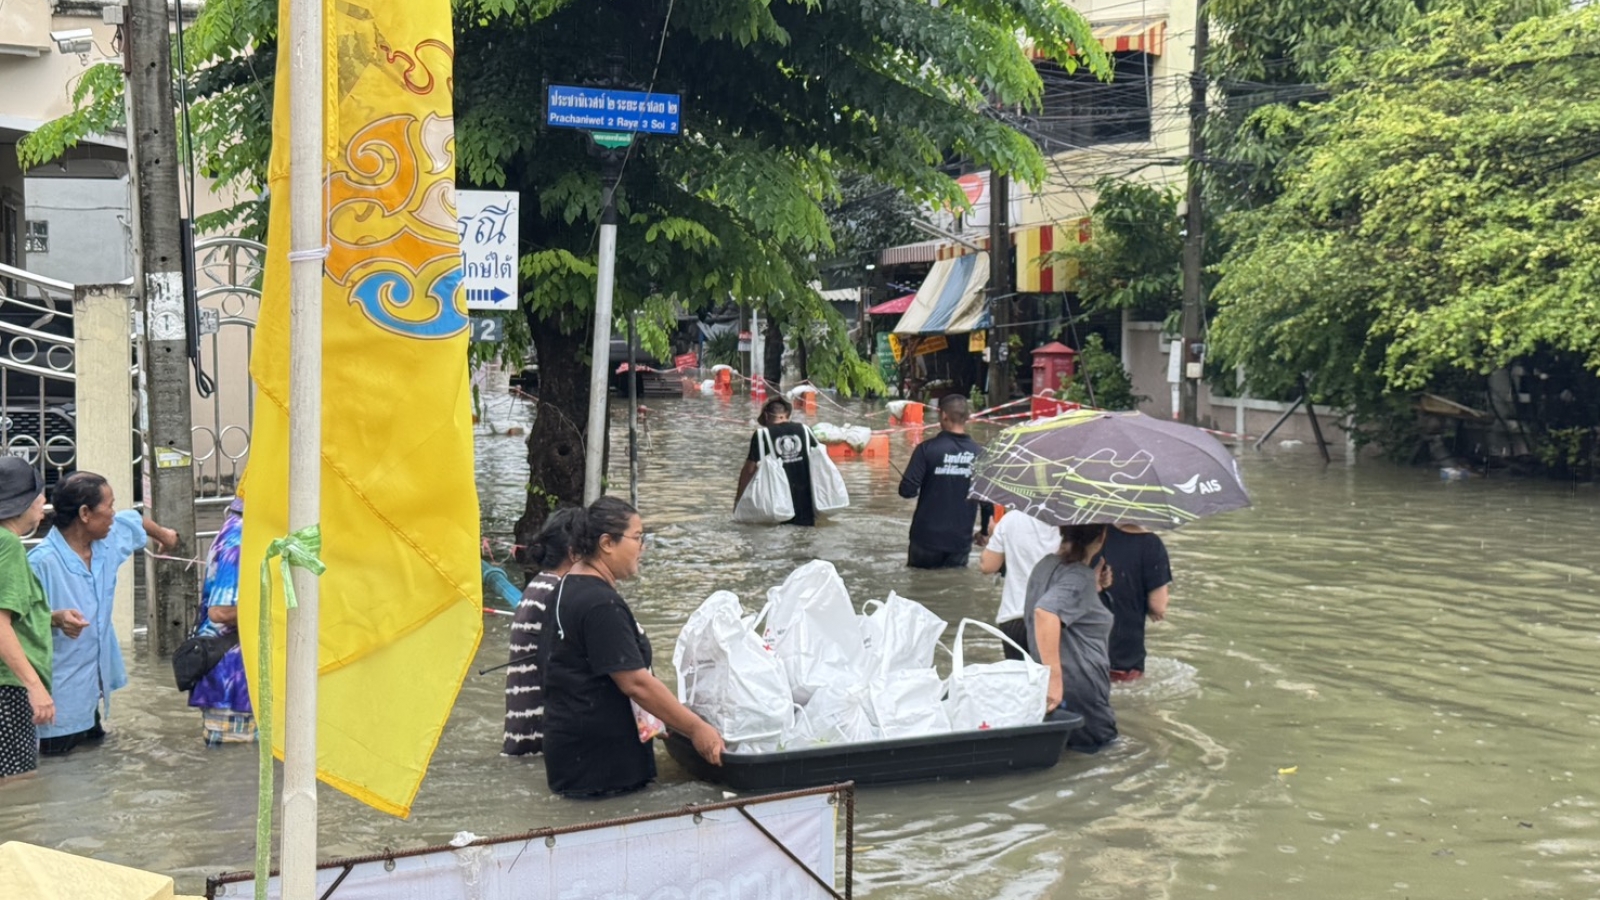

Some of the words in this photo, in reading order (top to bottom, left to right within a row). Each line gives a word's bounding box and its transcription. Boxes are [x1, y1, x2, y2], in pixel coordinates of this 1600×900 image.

[549, 112, 605, 126] Prachaniwet
[607, 117, 614, 127] 2
[616, 117, 639, 129] Raya
[641, 119, 648, 128] 3
[651, 119, 665, 129] Soi
[670, 121, 677, 130] 2
[480, 319, 496, 341] 2
[1199, 479, 1222, 495] AIS
